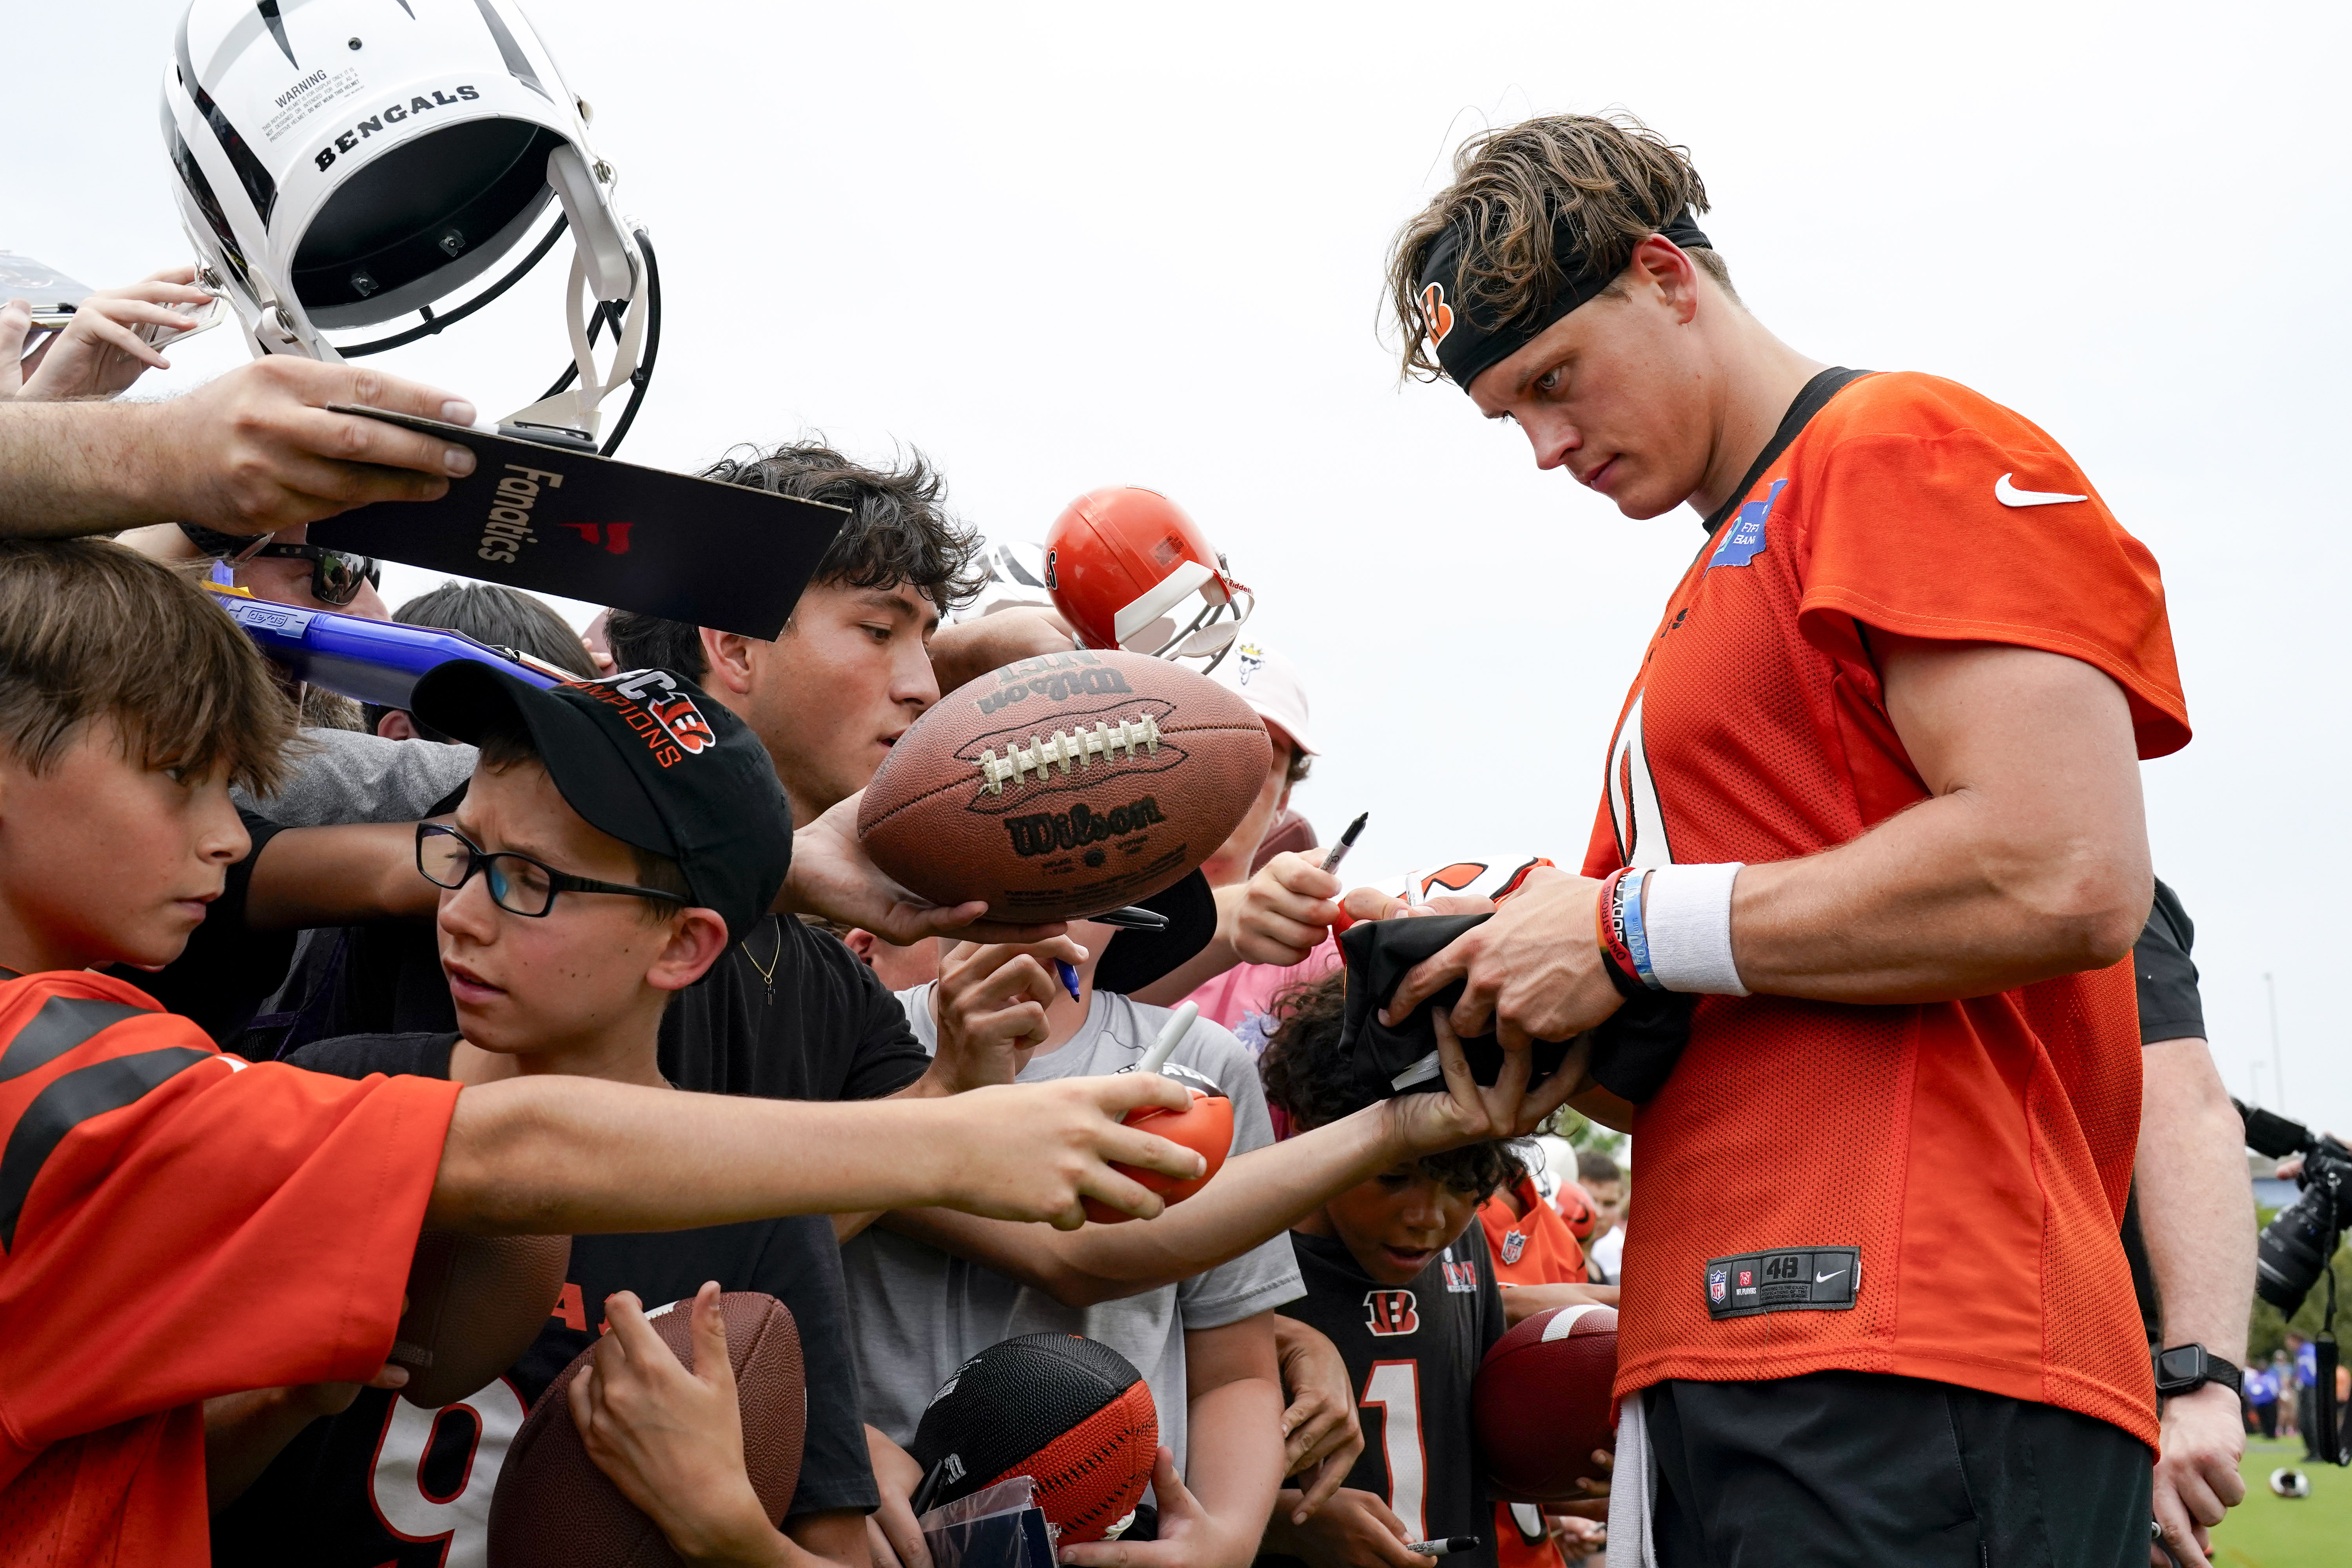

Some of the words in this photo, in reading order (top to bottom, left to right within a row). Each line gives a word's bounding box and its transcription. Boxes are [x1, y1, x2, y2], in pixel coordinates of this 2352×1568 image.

[262, 122, 271, 131] THIS
[270, 111, 286, 125] REPLICA
[286, 99, 301, 113] HELMET
[307, 90, 315, 98] FOR
[315, 79, 332, 93] DISPLAY
[269, 123, 291, 143] PROTECTIVE
[322, 94, 335, 103] WEAR
[344, 79, 360, 90] HELMET
[275, 70, 327, 107] WARNING
[275, 113, 294, 129] DESIGNED
[303, 94, 323, 108] INTENDED
[315, 85, 480, 172] BENGALS
[478, 464, 564, 564] Fanatics
[974, 667, 1134, 715] Wilson
[1003, 797, 1166, 858] Wilson
[1601, 886, 1611, 934] STRONG
[1612, 897, 1624, 942] BODY
[1608, 936, 1626, 960] ONE
[1712, 1283, 1724, 1299] NFL
[1766, 1256, 1798, 1279] 48
